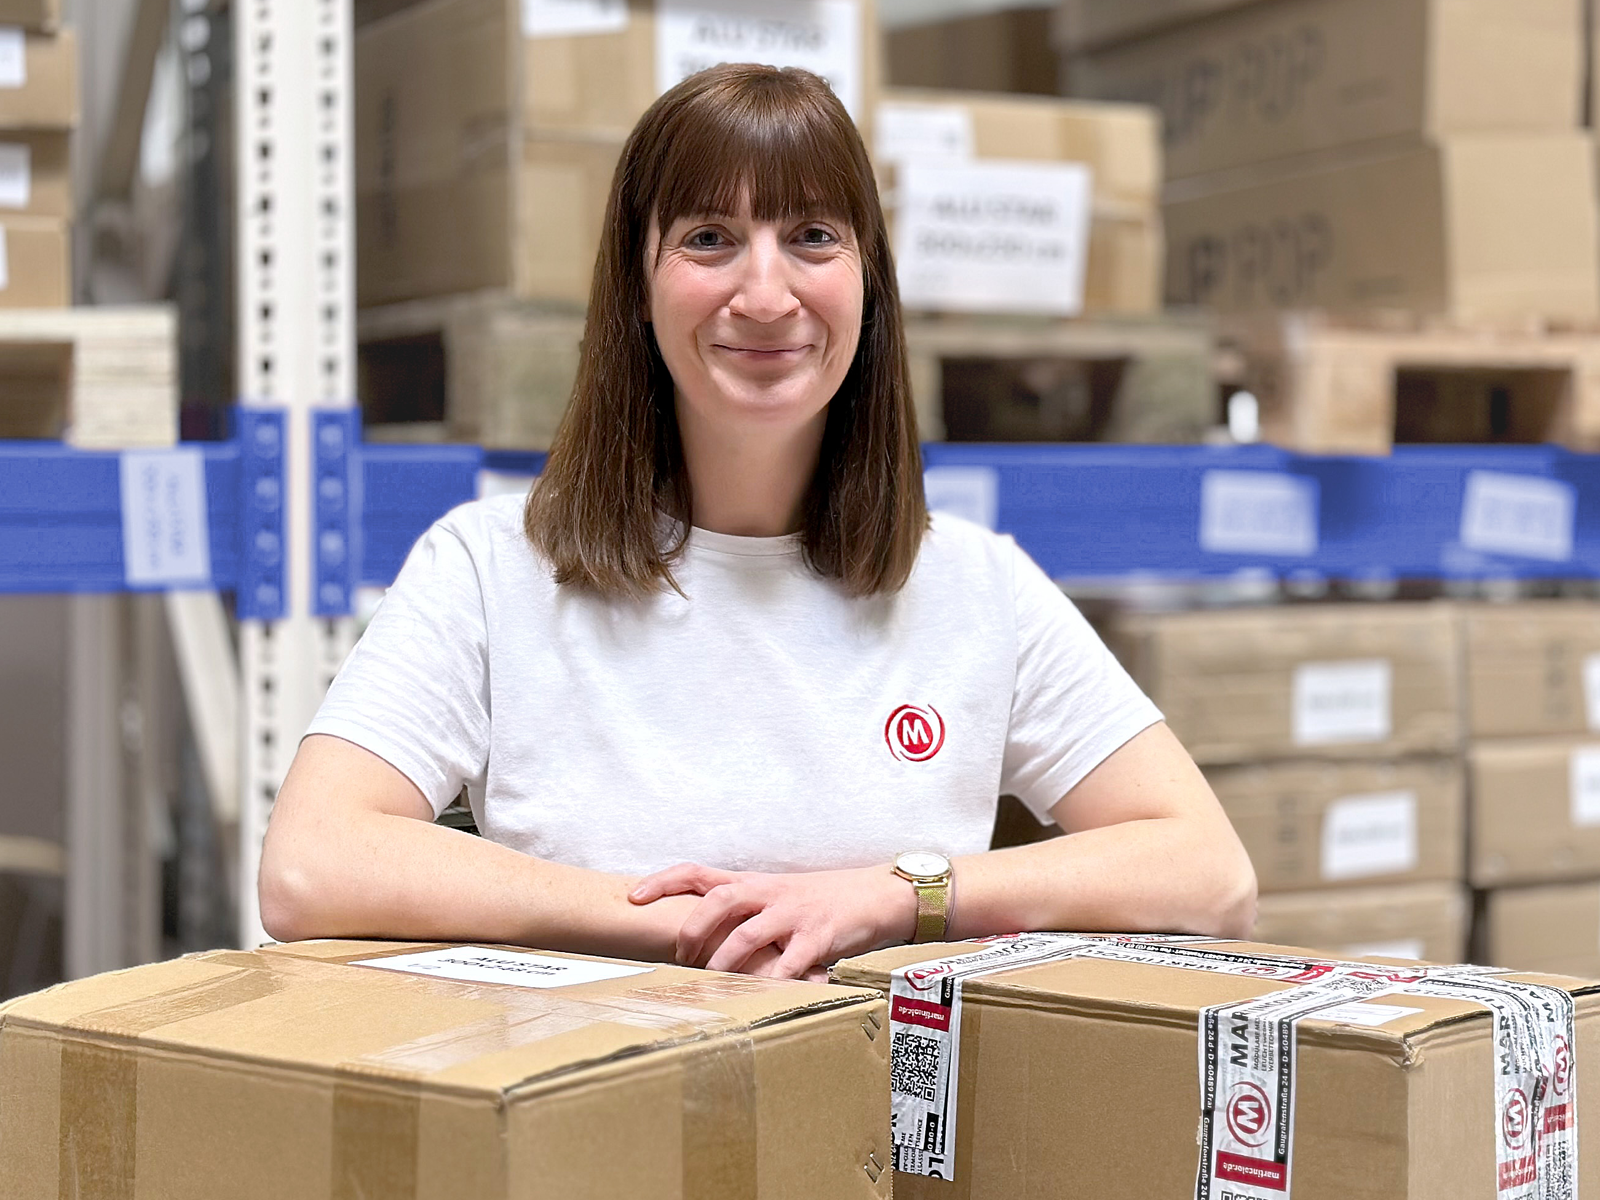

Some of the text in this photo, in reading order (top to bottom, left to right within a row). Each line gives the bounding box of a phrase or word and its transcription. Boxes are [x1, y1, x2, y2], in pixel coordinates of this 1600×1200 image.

[903, 719, 930, 746] M
[470, 956, 568, 971] ALU STAR
[1282, 1075, 1289, 1086] 24
[1223, 1162, 1280, 1180] martincolor.de
